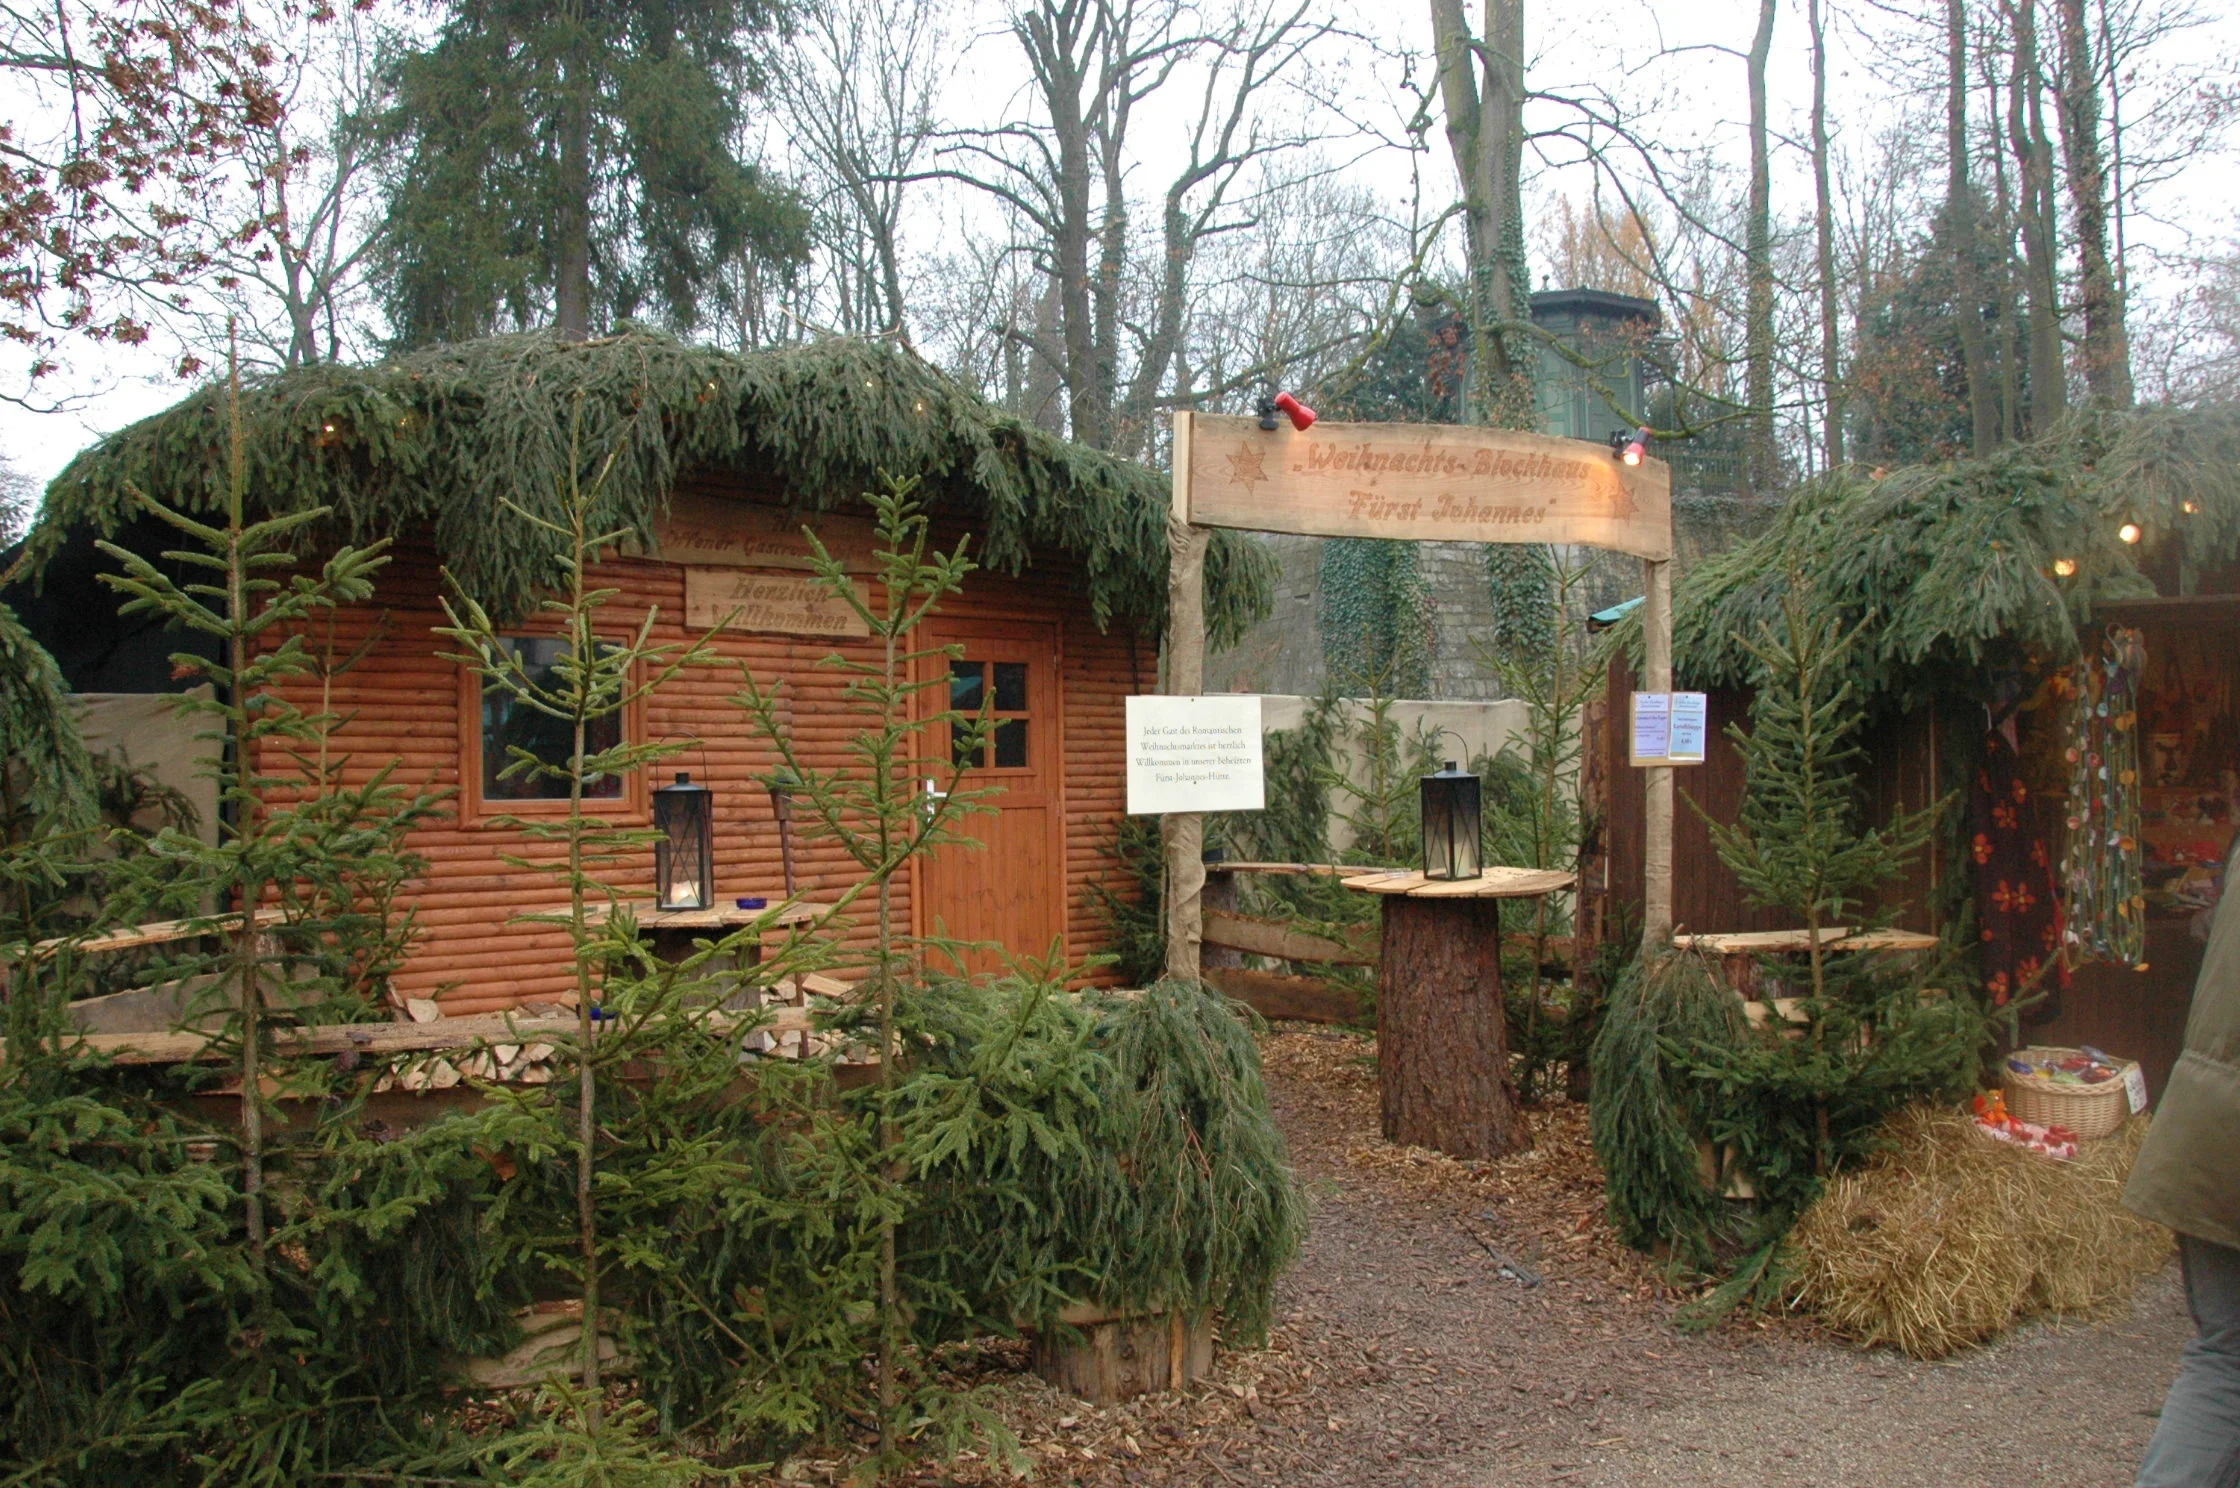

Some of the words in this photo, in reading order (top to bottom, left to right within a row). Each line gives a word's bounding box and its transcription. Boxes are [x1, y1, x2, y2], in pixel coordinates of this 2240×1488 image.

[1472, 448, 1592, 480] Blockhaus
[1348, 489, 1423, 521] Fürst
[729, 576, 828, 604] Herzlich
[1143, 726, 1161, 736] Jeder
[1163, 726, 1178, 735] Gast
[1193, 725, 1242, 735] Romantischen
[1208, 742, 1217, 750] ist
[1218, 740, 1246, 750] herzlich
[1136, 757, 1181, 766] Willkommen
[1183, 757, 1190, 766] in
